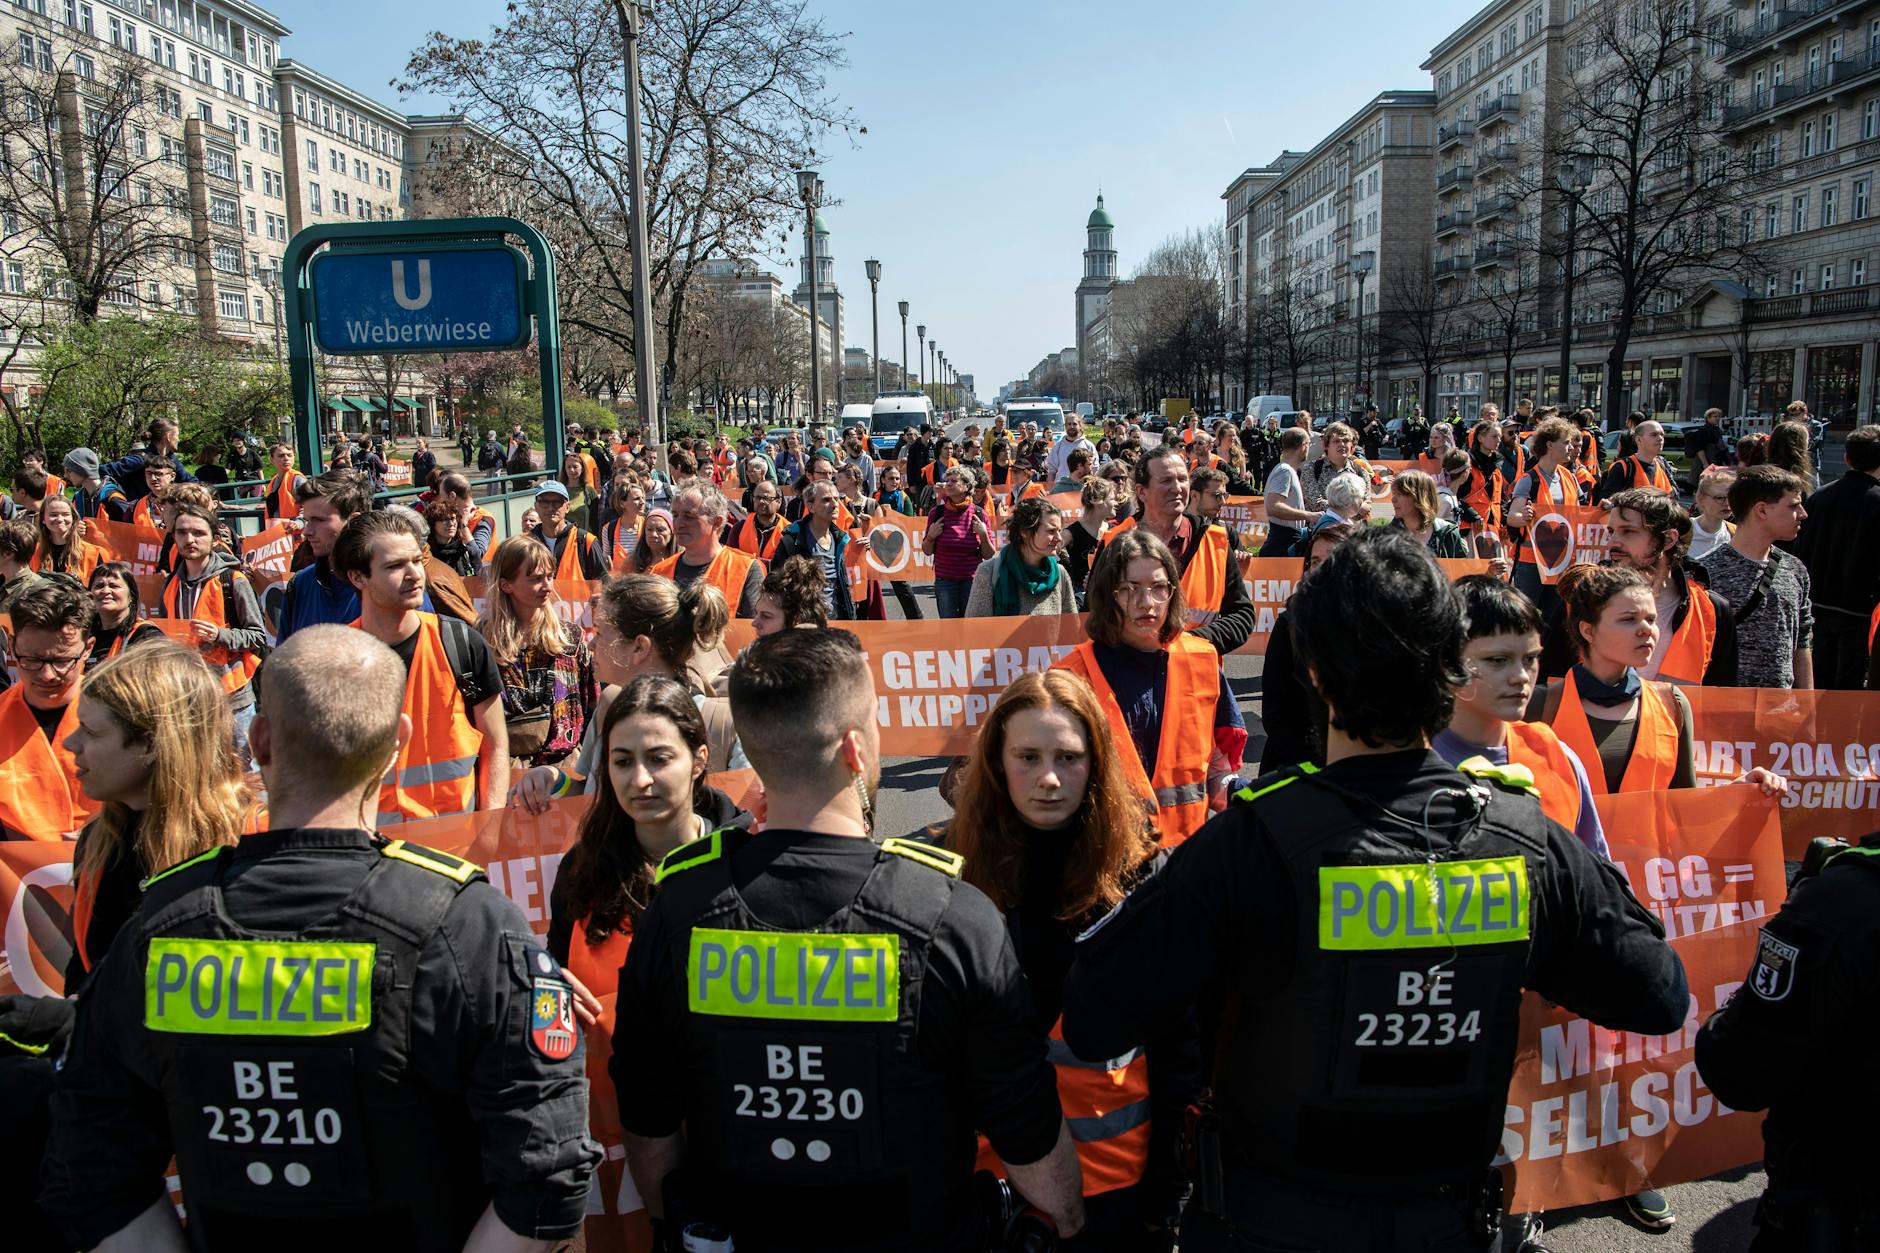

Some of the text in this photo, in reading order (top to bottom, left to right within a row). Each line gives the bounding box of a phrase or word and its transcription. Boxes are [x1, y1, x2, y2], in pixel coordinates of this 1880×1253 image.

[391, 259, 432, 310] U
[347, 318, 492, 344] Weberwiese
[1693, 740, 1756, 779] ART
[1768, 742, 1840, 778] 20A
[1644, 854, 1713, 901] GG
[1332, 871, 1520, 940] POLIZEI
[156, 952, 360, 1022] POLIZEI
[698, 942, 886, 1008] POLIZEI
[1397, 970, 1455, 1006] BE
[1355, 1010, 1481, 1046] 23234
[233, 1061, 299, 1100] BE
[766, 1044, 825, 1081] BE
[733, 1084, 864, 1121] 23230
[1490, 1061, 1736, 1167] SELLSC
[202, 1105, 342, 1145] 23210
